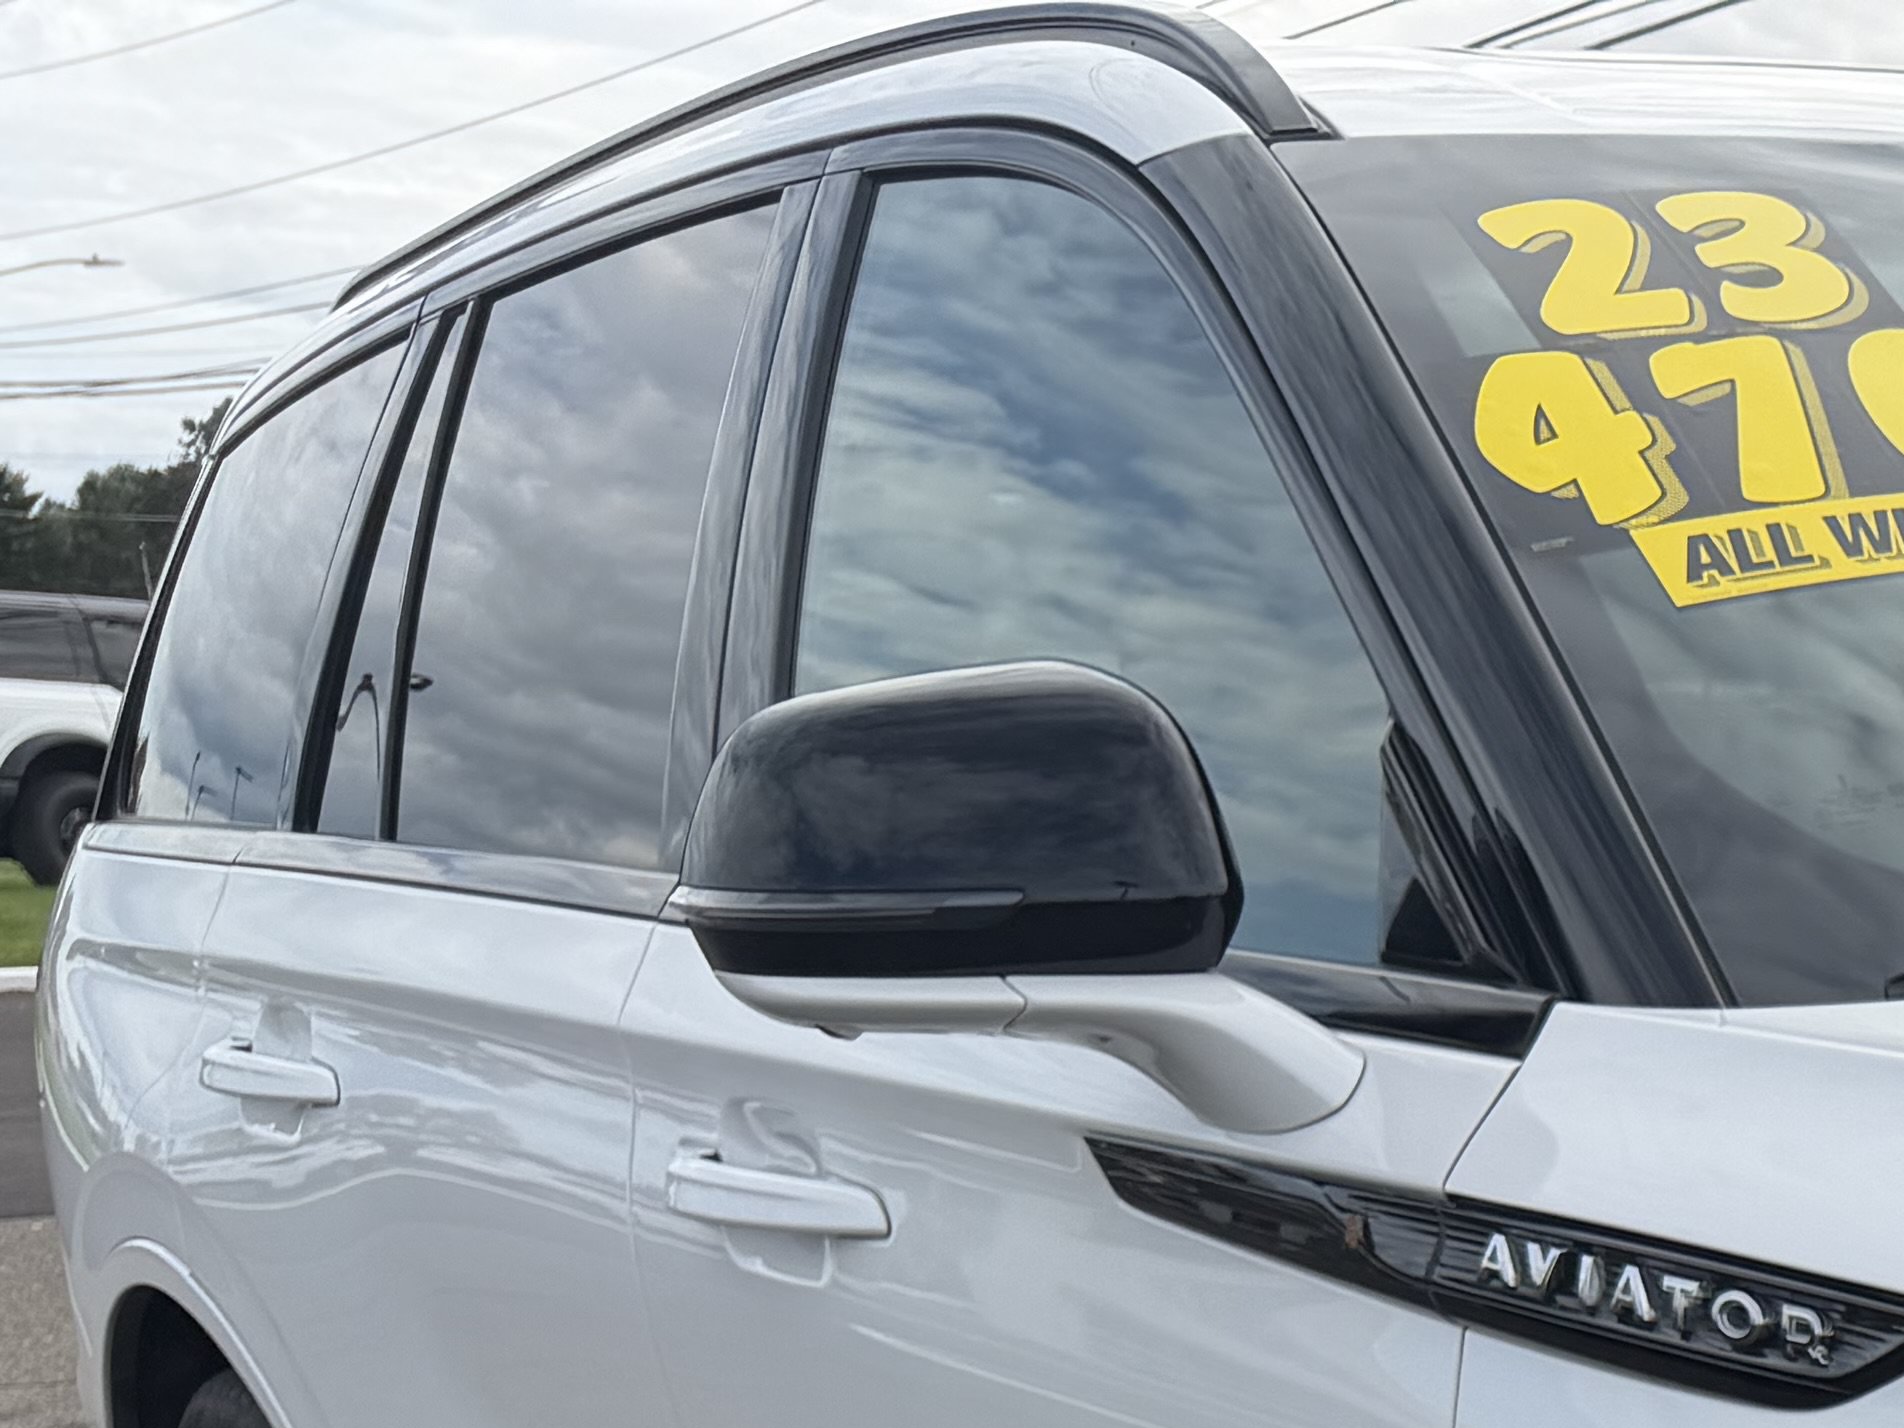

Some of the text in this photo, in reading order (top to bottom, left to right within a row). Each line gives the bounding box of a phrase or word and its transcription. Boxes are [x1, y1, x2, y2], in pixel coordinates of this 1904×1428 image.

[1476, 190, 1862, 337] 23
[1685, 521, 1822, 585] ALL
[1480, 1231, 1832, 1367] AVIATOR
